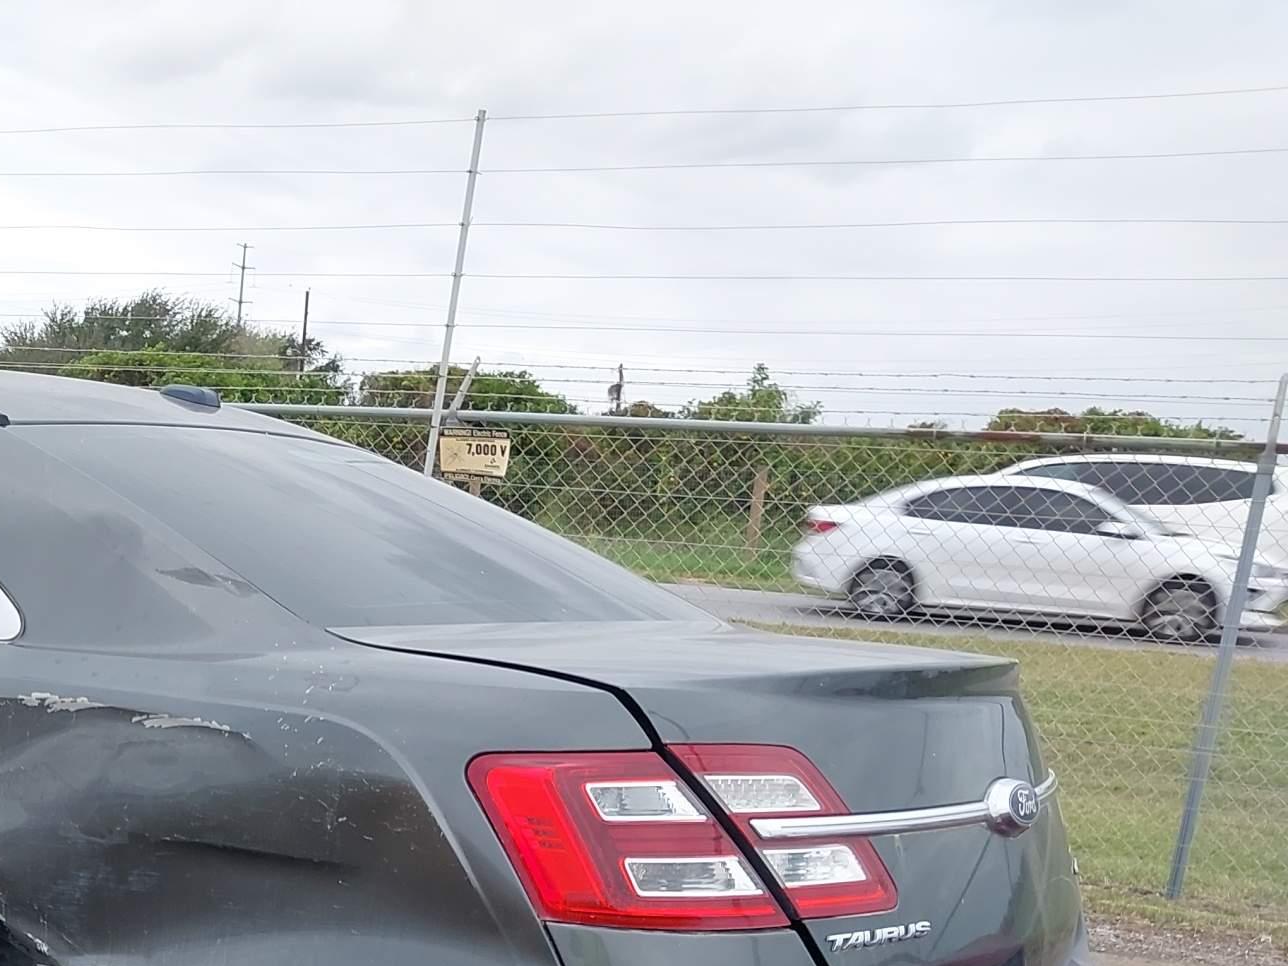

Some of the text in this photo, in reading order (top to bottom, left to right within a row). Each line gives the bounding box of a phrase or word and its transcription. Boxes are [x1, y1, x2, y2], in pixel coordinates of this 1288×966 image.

[465, 443, 508, 457] 7,000 V
[1017, 789, 1037, 817] Ford
[825, 921, 931, 951] TAURUS
